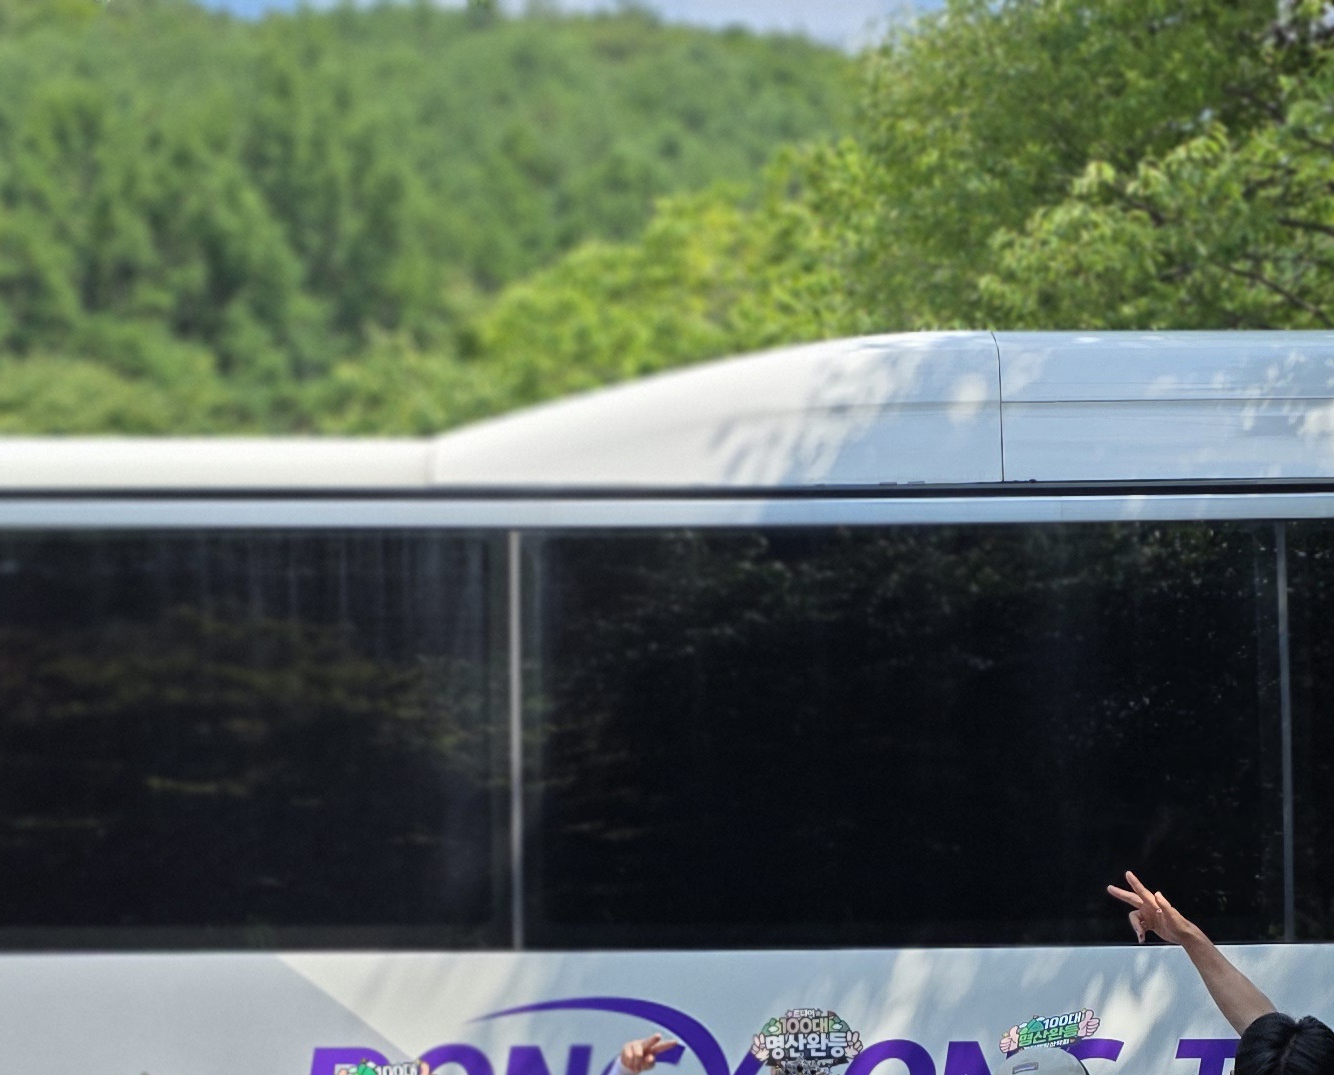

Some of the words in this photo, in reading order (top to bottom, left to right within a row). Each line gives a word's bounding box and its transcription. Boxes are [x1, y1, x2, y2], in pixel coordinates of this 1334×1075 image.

[778, 1017, 827, 1034] 100대
[1042, 1011, 1082, 1030] 100대
[1018, 1023, 1079, 1047] 명산완등
[765, 1032, 848, 1060] 명산완등
